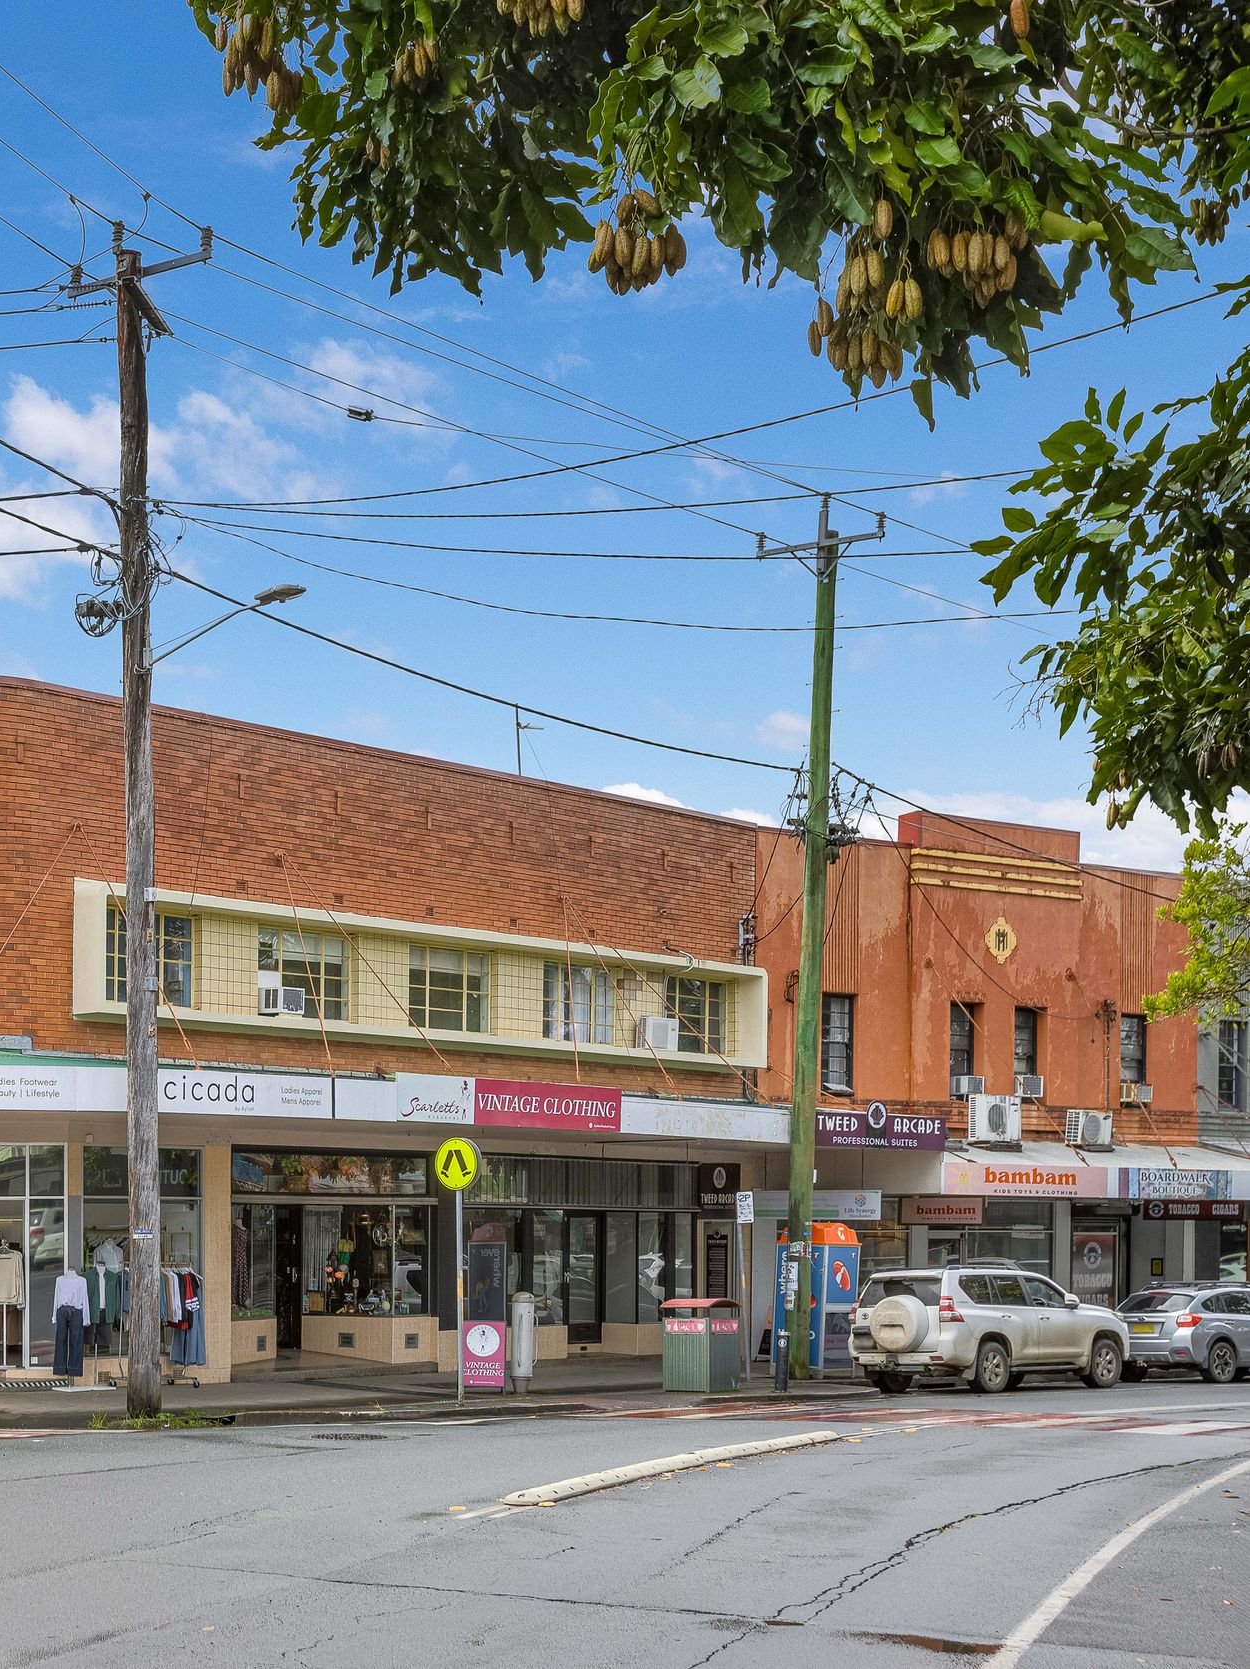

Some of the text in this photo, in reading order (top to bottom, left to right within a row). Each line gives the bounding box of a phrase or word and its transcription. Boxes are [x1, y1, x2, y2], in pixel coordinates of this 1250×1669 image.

[20, 1078, 57, 1086] Footwear
[27, 1089, 60, 1098] Lifestyle
[164, 1075, 254, 1103] cicada
[301, 1088, 322, 1096] Apparel
[299, 1098, 321, 1106] Apparel
[478, 1093, 616, 1118] VINTAGE CLOTHING
[818, 1115, 941, 1135] TWEED ARCADE
[833, 1136, 918, 1147] PROFESSIONAL SUITES
[984, 1167, 1077, 1185] bambam
[1141, 1172, 1211, 1185] BOARDWALK
[701, 1193, 735, 1204] TWEED ARCAD
[739, 1194, 751, 1202] 2P
[916, 1205, 976, 1215] bambam
[1169, 1204, 1200, 1215] TOBACCO
[1212, 1204, 1239, 1215] CIGARS
[1073, 1273, 1112, 1288] TOBACCO
